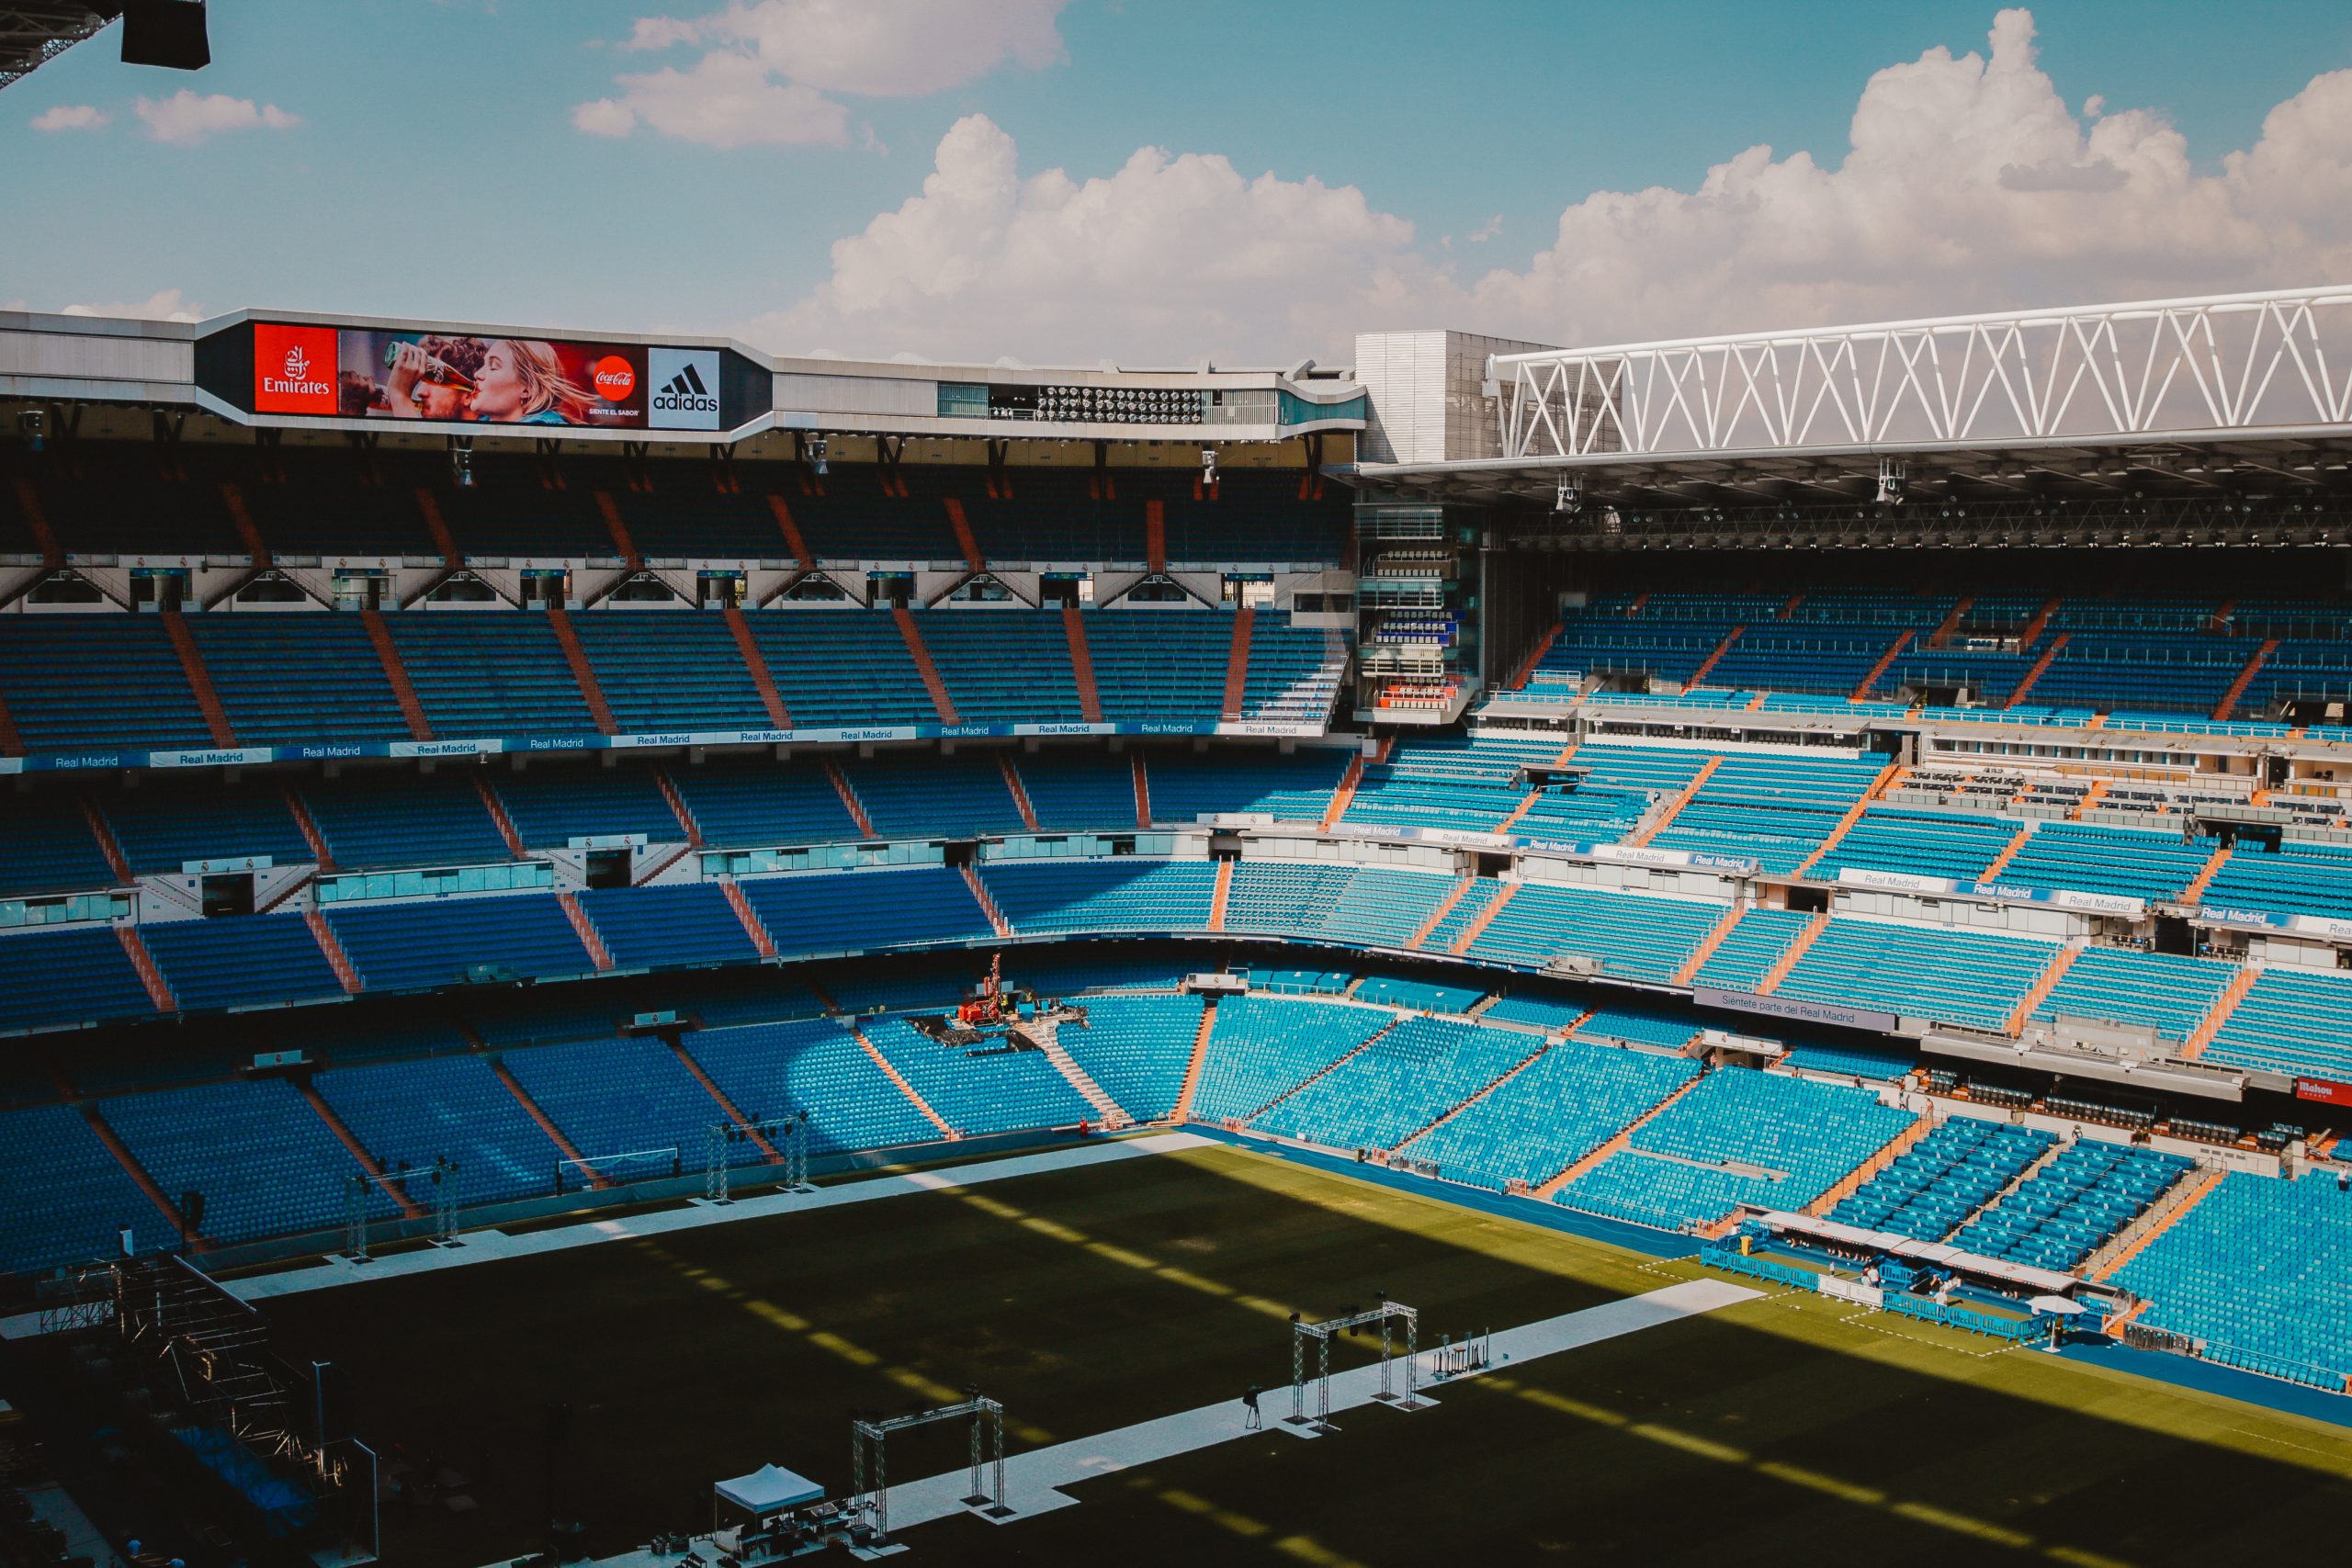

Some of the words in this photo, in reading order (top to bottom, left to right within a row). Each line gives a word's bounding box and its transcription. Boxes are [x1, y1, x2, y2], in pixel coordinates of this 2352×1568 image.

[595, 371, 633, 386] Coca-Cola
[264, 377, 330, 395] Emirates
[653, 393, 718, 412] adidas
[942, 727, 960, 736] Real
[962, 726, 989, 735] Madrid
[1039, 725, 1057, 734] Real
[1059, 724, 1090, 733] Madrid
[1142, 724, 1160, 733] Real
[1162, 724, 1193, 733] Madrid
[1246, 726, 1265, 735] Real
[1267, 726, 1296, 735] Madrid
[638, 735, 657, 744] Real
[659, 734, 690, 743] Madrid
[741, 732, 761, 741] Real
[763, 731, 793, 740] Madrid
[841, 731, 860, 740] Real
[862, 730, 892, 739] Madrid
[418, 744, 439, 755] Real
[441, 743, 476, 753] Madrid
[530, 739, 550, 749] Real
[552, 738, 583, 748] Madrid
[303, 747, 324, 757] Real
[326, 746, 360, 756] Madrid
[56, 758, 79, 768] Real
[83, 756, 119, 767] Madrid
[181, 754, 203, 765] Real
[207, 752, 243, 763] Madrid
[1354, 825, 1371, 835] Real
[1373, 827, 1400, 837] Madrid
[1442, 833, 1461, 842] Real
[1463, 835, 1487, 845] Madrid
[1531, 840, 1548, 851] Real
[1550, 841, 1576, 852] Madrid
[1616, 850, 1635, 860] Real
[1637, 852, 1665, 863] Madrid
[1695, 855, 1713, 865] Real
[1715, 857, 1745, 868] Madrid
[1864, 874, 1884, 886] Real
[1886, 876, 1920, 890] Madrid
[1974, 884, 1995, 896] Real
[1997, 886, 2031, 899] Madrid
[2069, 896, 2091, 908] Real
[2094, 897, 2131, 911] Madrid
[2201, 908, 2225, 919] Real
[2227, 909, 2267, 923] Madrid
[2330, 924, 2352, 935] Rea
[1759, 1002, 1781, 1012] parte
[1784, 1005, 1798, 1014] del
[1801, 1007, 1820, 1018] Real
[1823, 1010, 1855, 1022] Madrid
[2300, 1082, 2333, 1095] Mahou
